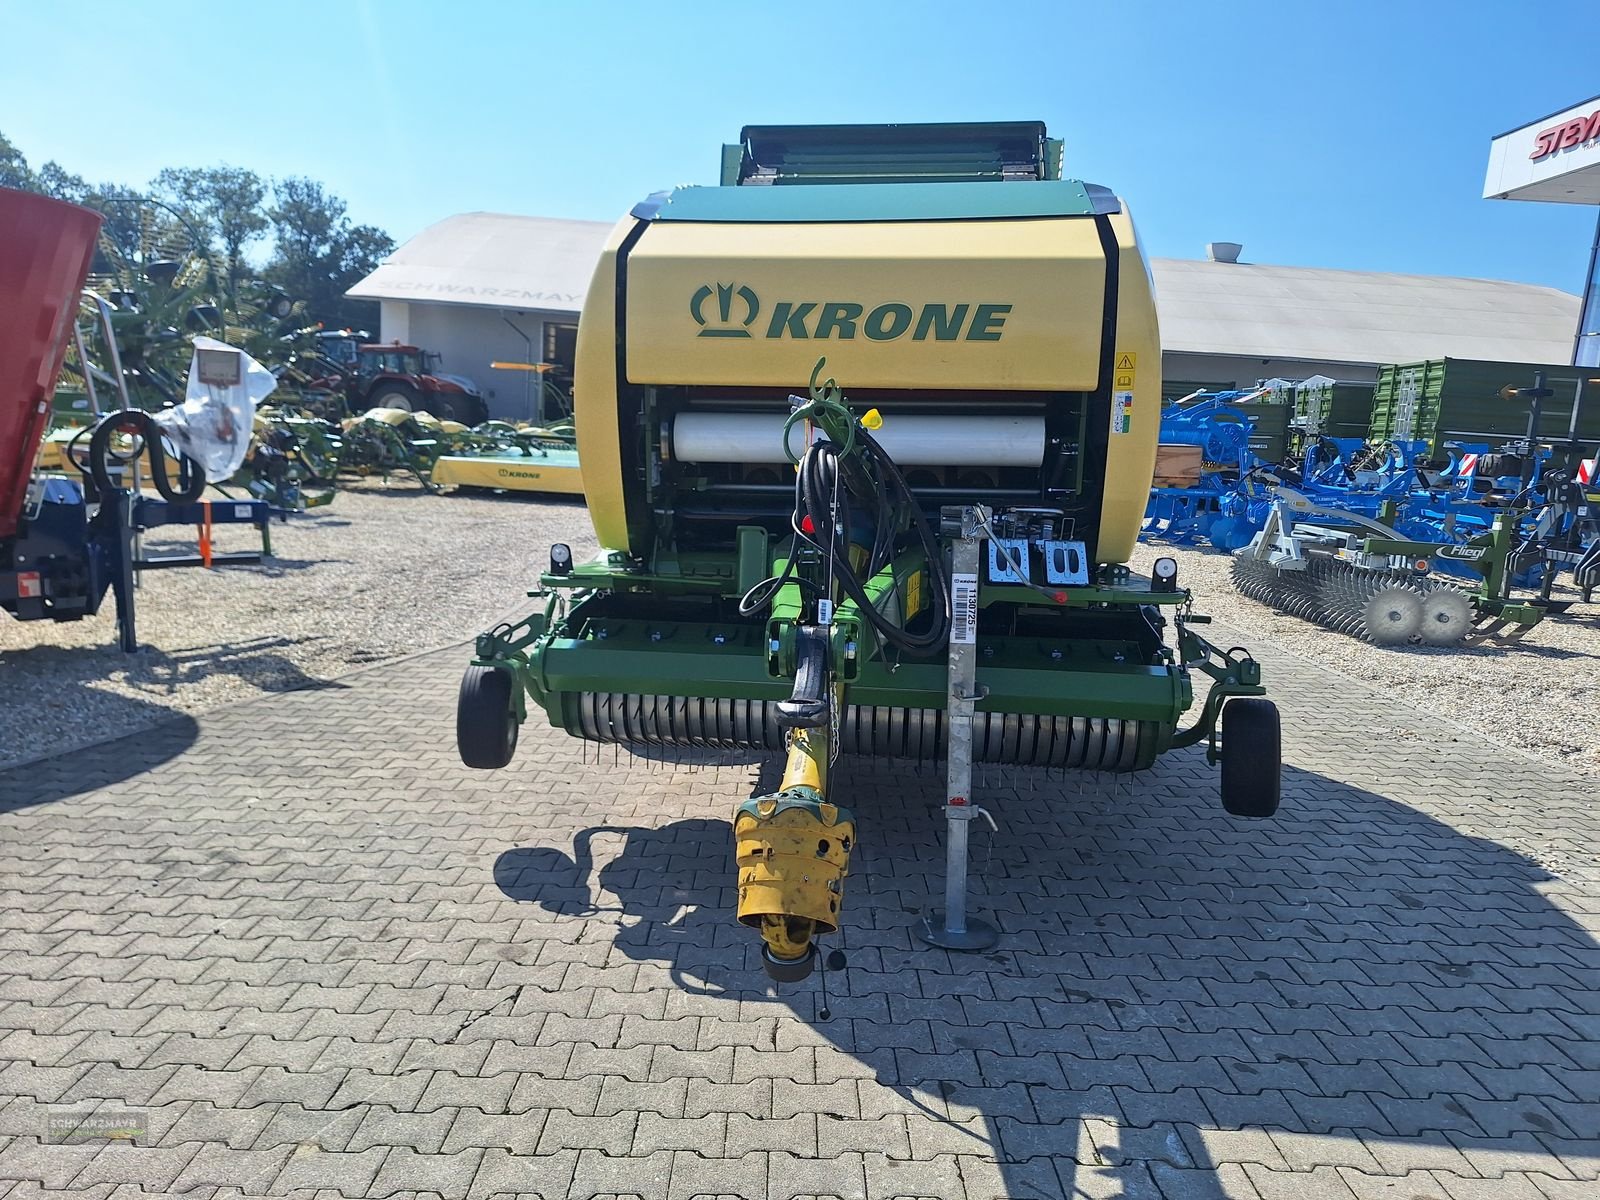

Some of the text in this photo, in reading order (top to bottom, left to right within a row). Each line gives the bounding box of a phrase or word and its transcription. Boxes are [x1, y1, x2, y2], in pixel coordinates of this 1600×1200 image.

[377, 281, 584, 301] SCHWARZMAY
[765, 302, 1014, 341] KRONE
[509, 471, 541, 479] KRONE
[1450, 545, 1487, 559] Fliegl
[967, 588, 977, 625] 1130725
